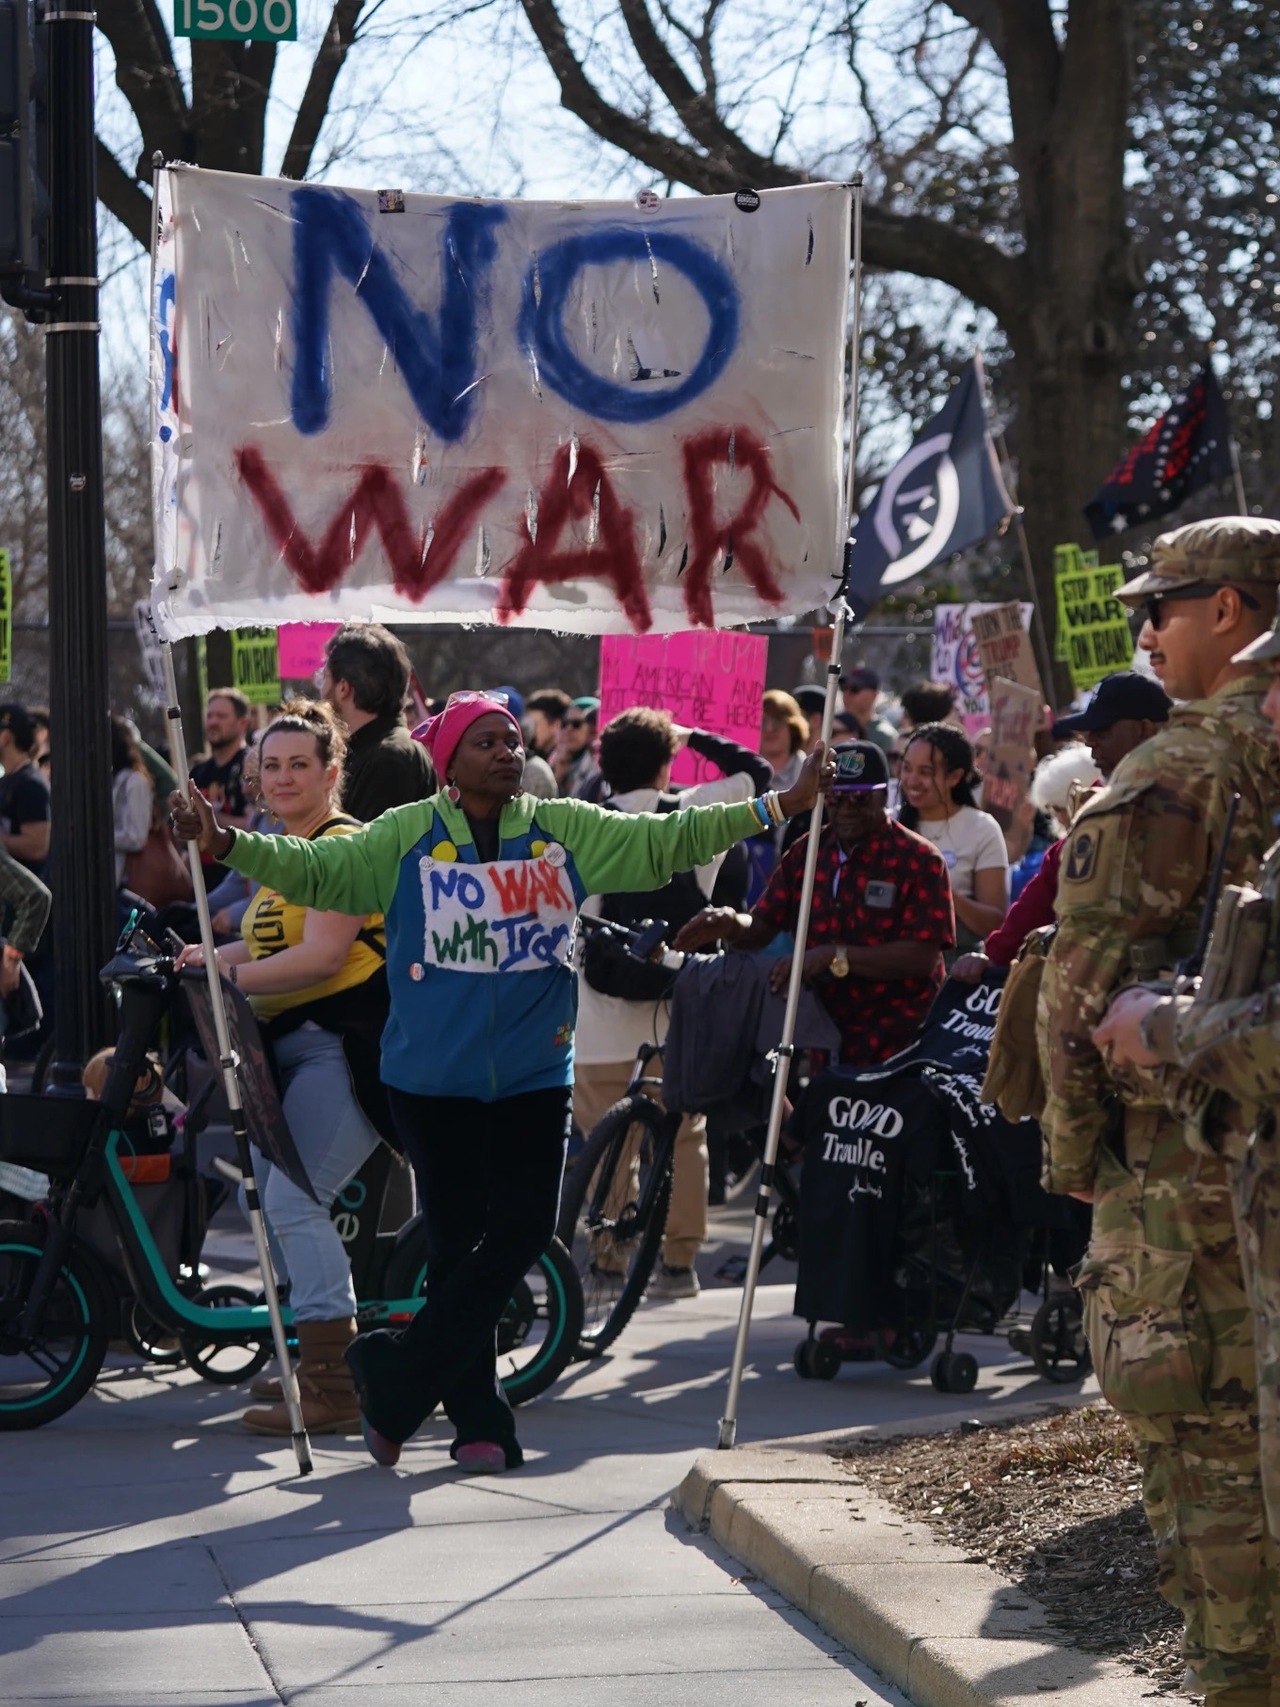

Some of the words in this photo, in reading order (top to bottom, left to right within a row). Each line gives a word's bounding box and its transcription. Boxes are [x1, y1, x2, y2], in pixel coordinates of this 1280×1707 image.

[183, 0, 292, 34] 1500
[291, 189, 740, 441] NO
[234, 425, 800, 633] WAR
[1065, 600, 1121, 627] WAR
[430, 868, 485, 911] NO
[488, 859, 573, 915] WAR
[431, 913, 499, 967] with
[828, 1096, 904, 1139] GOOD
